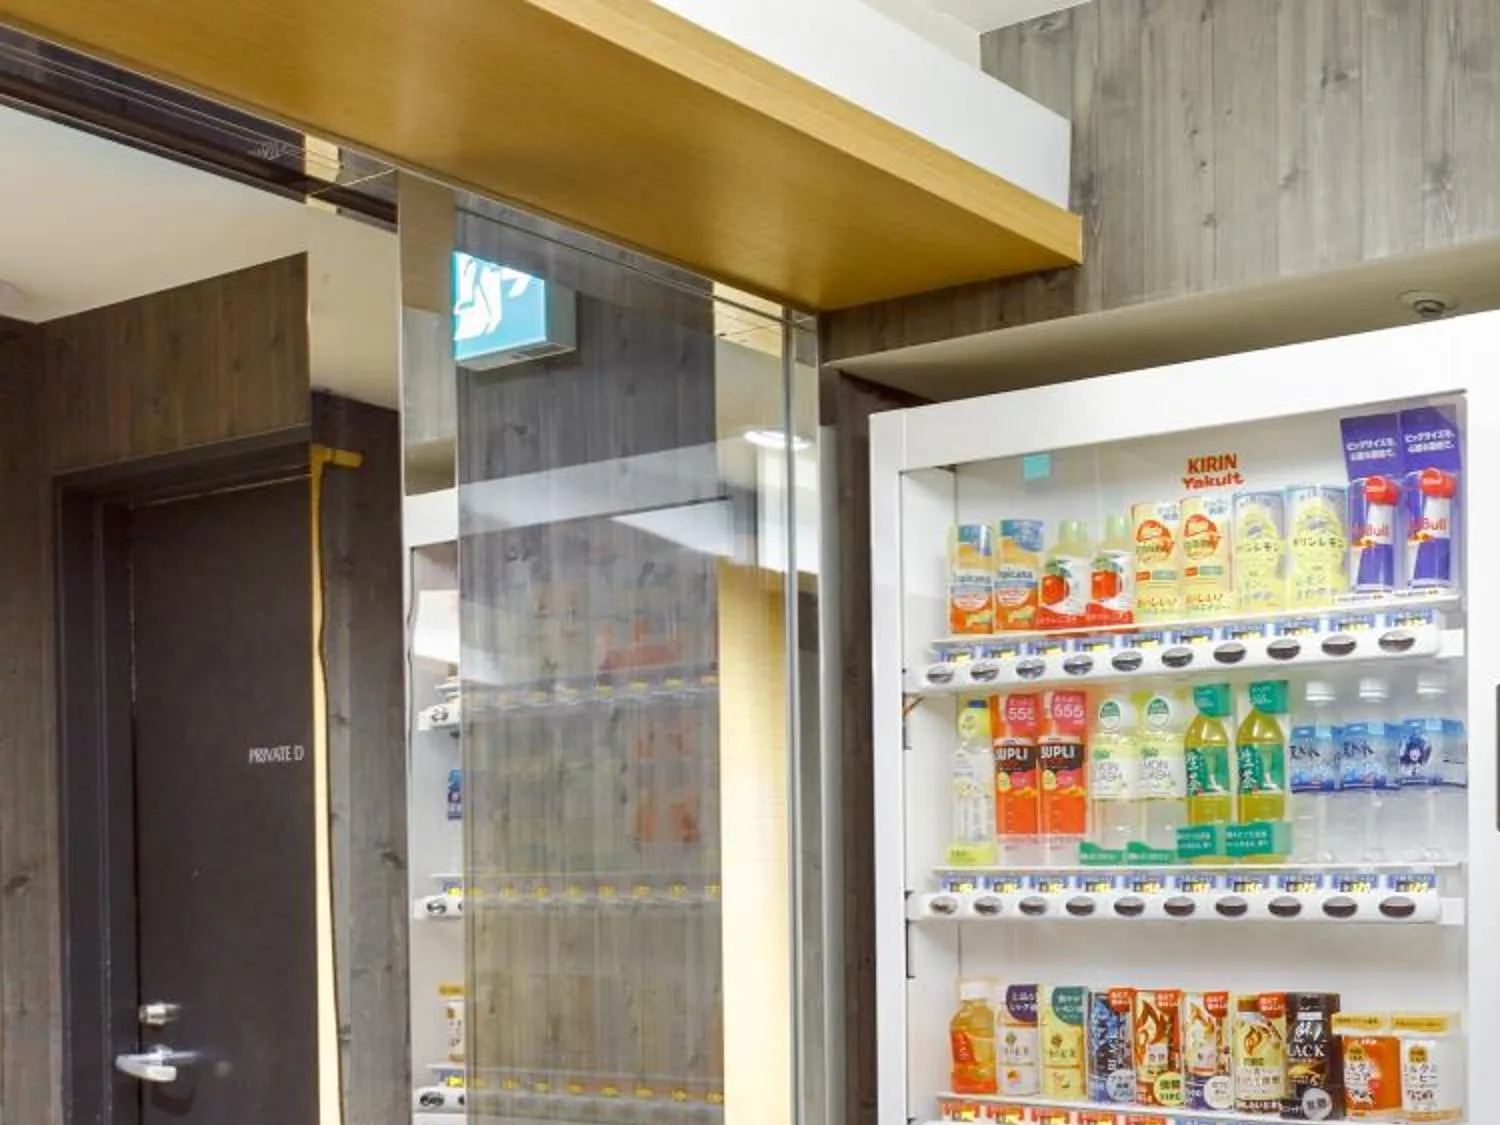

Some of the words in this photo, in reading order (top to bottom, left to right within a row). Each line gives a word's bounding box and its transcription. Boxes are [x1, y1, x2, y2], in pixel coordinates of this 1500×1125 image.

[1188, 453, 1238, 475] KIRIN
[1182, 471, 1245, 490] Yakult
[249, 746, 292, 764] PRIVATE
